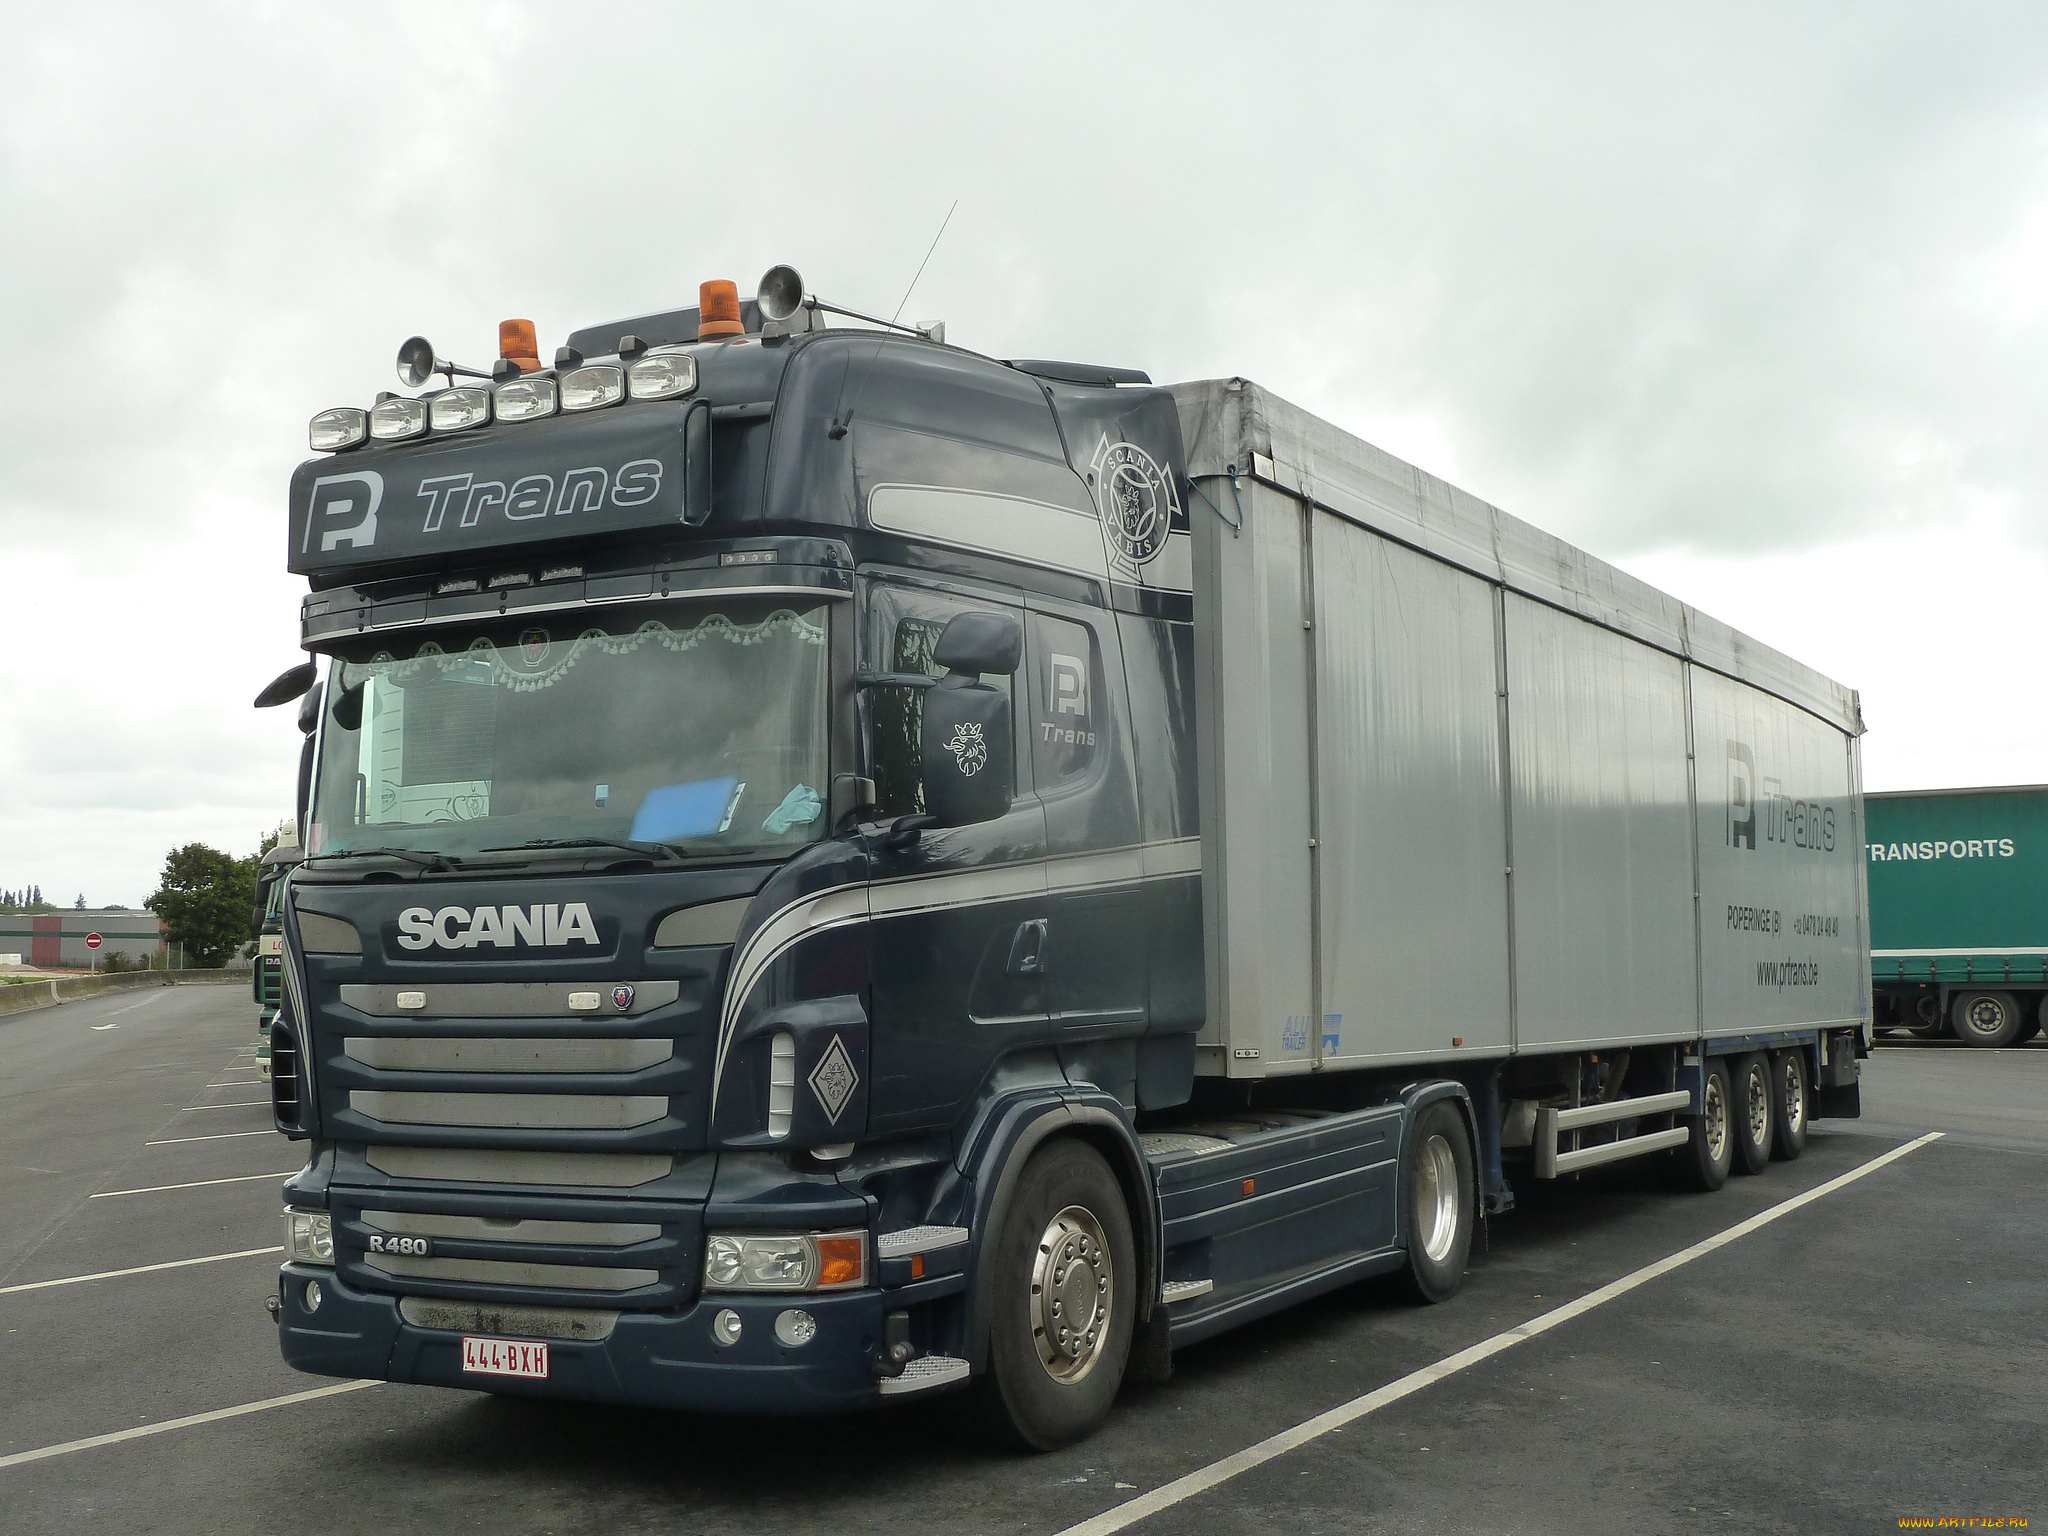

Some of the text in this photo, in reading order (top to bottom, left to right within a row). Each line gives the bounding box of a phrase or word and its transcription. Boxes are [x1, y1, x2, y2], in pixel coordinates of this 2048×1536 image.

[1107, 449, 1160, 492] SCANIA
[417, 458, 664, 532] Trans
[1107, 512, 1152, 556] VABIS
[1041, 722, 1096, 746] Trans
[1763, 776, 1836, 852] Trans
[1865, 838, 2015, 861] RANSPORTS
[397, 902, 600, 950] SCANIA
[1727, 905, 1771, 933] POPERINGE
[265, 957, 282, 965] DA
[1757, 956, 1818, 994] www.prtrans.be
[1282, 1015, 1310, 1037] ALU
[1282, 1037, 1307, 1052] TRAILER
